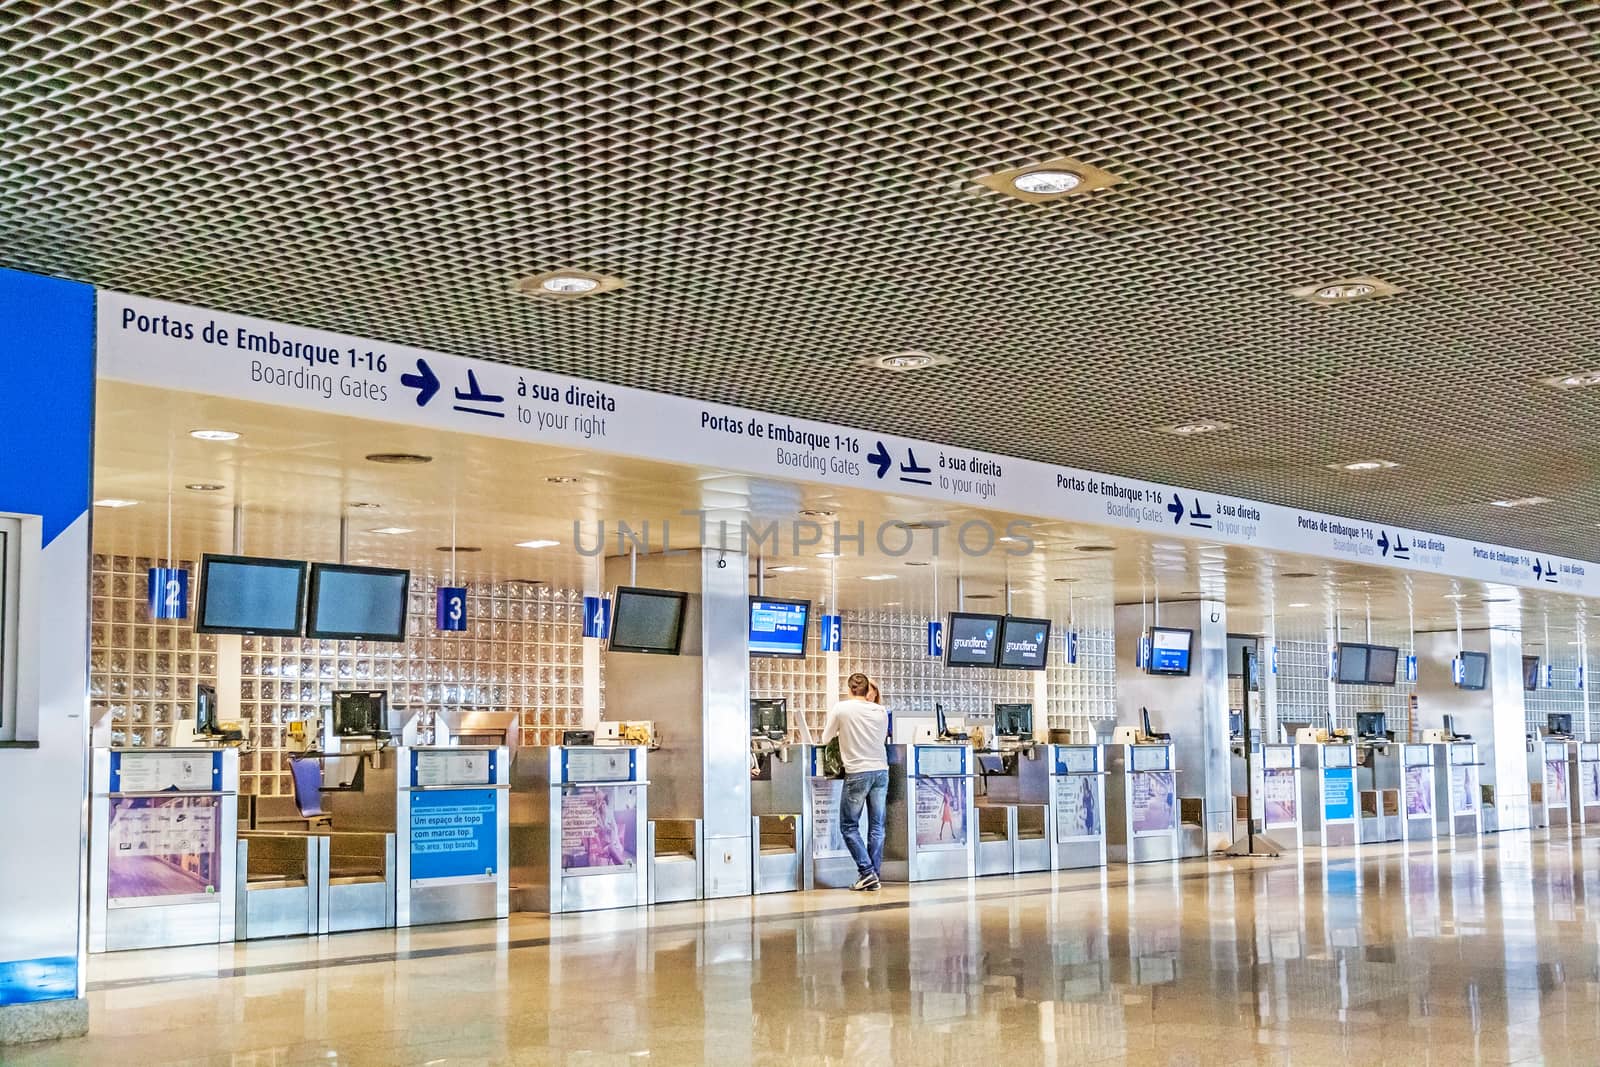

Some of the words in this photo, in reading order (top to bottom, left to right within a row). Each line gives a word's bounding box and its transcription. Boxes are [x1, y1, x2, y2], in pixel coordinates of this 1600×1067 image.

[121, 307, 195, 340] Portas
[202, 320, 229, 346] de
[237, 328, 340, 367] Embarque
[347, 348, 388, 373] 1-16
[251, 360, 333, 399] Boarding
[340, 375, 388, 402] Gates
[517, 376, 527, 397] à
[532, 384, 560, 402] sua
[565, 384, 616, 412] direita
[518, 404, 532, 424] to
[537, 409, 569, 431] your
[574, 413, 606, 439] right
[701, 411, 744, 435] Portas
[747, 418, 764, 438] de
[768, 423, 830, 450] Embarque
[834, 435, 859, 454] 1-16
[776, 447, 827, 476] Boarding
[830, 456, 860, 476] Gates
[939, 451, 945, 468] à
[948, 457, 966, 471] sua
[969, 456, 1002, 477] direita
[940, 475, 949, 490] to
[952, 479, 972, 495] your
[975, 480, 996, 500] right
[1057, 474, 1085, 491] Portas
[1087, 478, 1099, 494] de
[1101, 482, 1142, 503] Embarque
[1145, 489, 1162, 504] 1-16
[1107, 501, 1141, 523] Boarding
[1142, 507, 1163, 523] Gates
[1223, 504, 1236, 516] sua
[1237, 504, 1260, 521] direita
[1297, 515, 1319, 531] Portas
[1320, 519, 1328, 533] de
[1329, 521, 1359, 539] Embarque
[1361, 527, 1374, 540] 1-16
[165, 579, 181, 606] 2
[449, 596, 463, 621] 3
[593, 607, 606, 629] 4
[935, 630, 943, 649] 6
[953, 636, 988, 650] groundforce
[1005, 640, 1038, 653] groundforce
[414, 817, 427, 825] Um
[428, 817, 453, 825] espaço
[454, 815, 463, 823] de
[464, 815, 481, 824] topo
[414, 830, 430, 838] com
[431, 829, 456, 837] marcas
